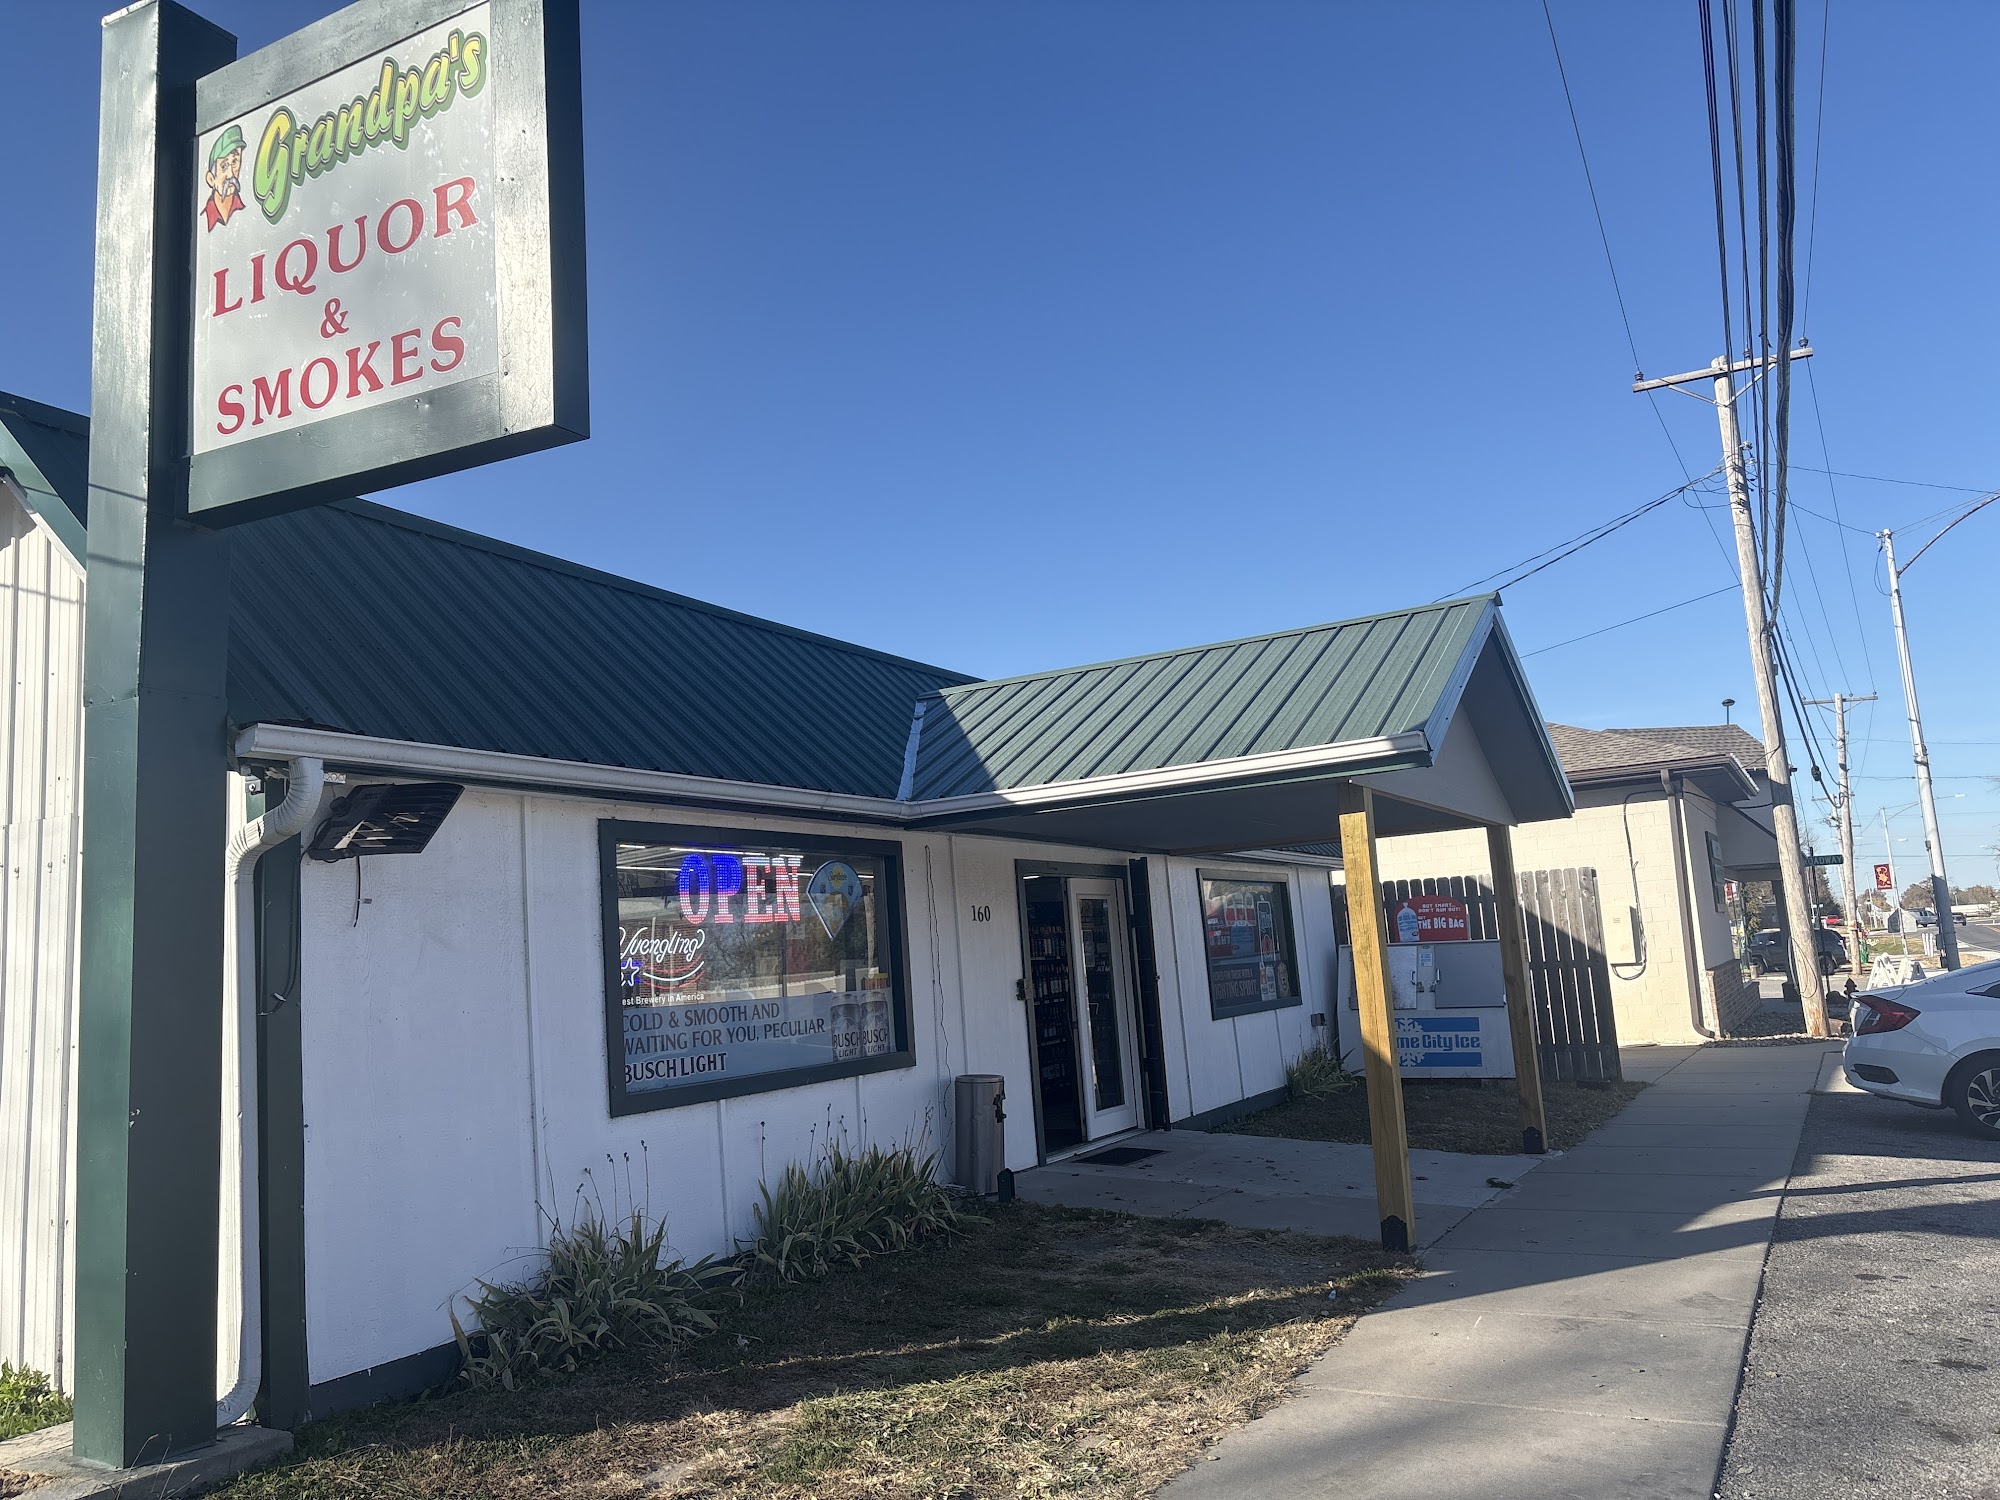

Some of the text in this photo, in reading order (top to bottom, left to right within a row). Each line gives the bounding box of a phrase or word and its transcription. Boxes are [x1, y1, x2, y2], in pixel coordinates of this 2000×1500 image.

[253, 28, 487, 225] Grandpa's
[212, 176, 480, 317] LIQUOR
[320, 297, 350, 339] &
[216, 315, 466, 435] SMOKES
[1803, 856, 1842, 866] ROADWAY
[678, 854, 801, 925] OPEN
[971, 905, 990, 922] 160
[1418, 919, 1431, 929] THE
[1433, 916, 1447, 929] BIG
[1448, 917, 1465, 928] BAG
[619, 927, 705, 963] Yuengling
[622, 993, 705, 1006] est Brewery in America
[623, 1002, 780, 1033] COLD & SMOOTH AND
[625, 1018, 826, 1056] WAITING FOR YOU, PECULIAR
[833, 1031, 861, 1049] BUSCH
[862, 1027, 889, 1046] BUSCH
[867, 1043, 886, 1054] LIGHT
[1396, 1034, 1480, 1051] me City Ice
[838, 1047, 858, 1058] LIGHT
[625, 1052, 727, 1084] BUSCH LIGHT
